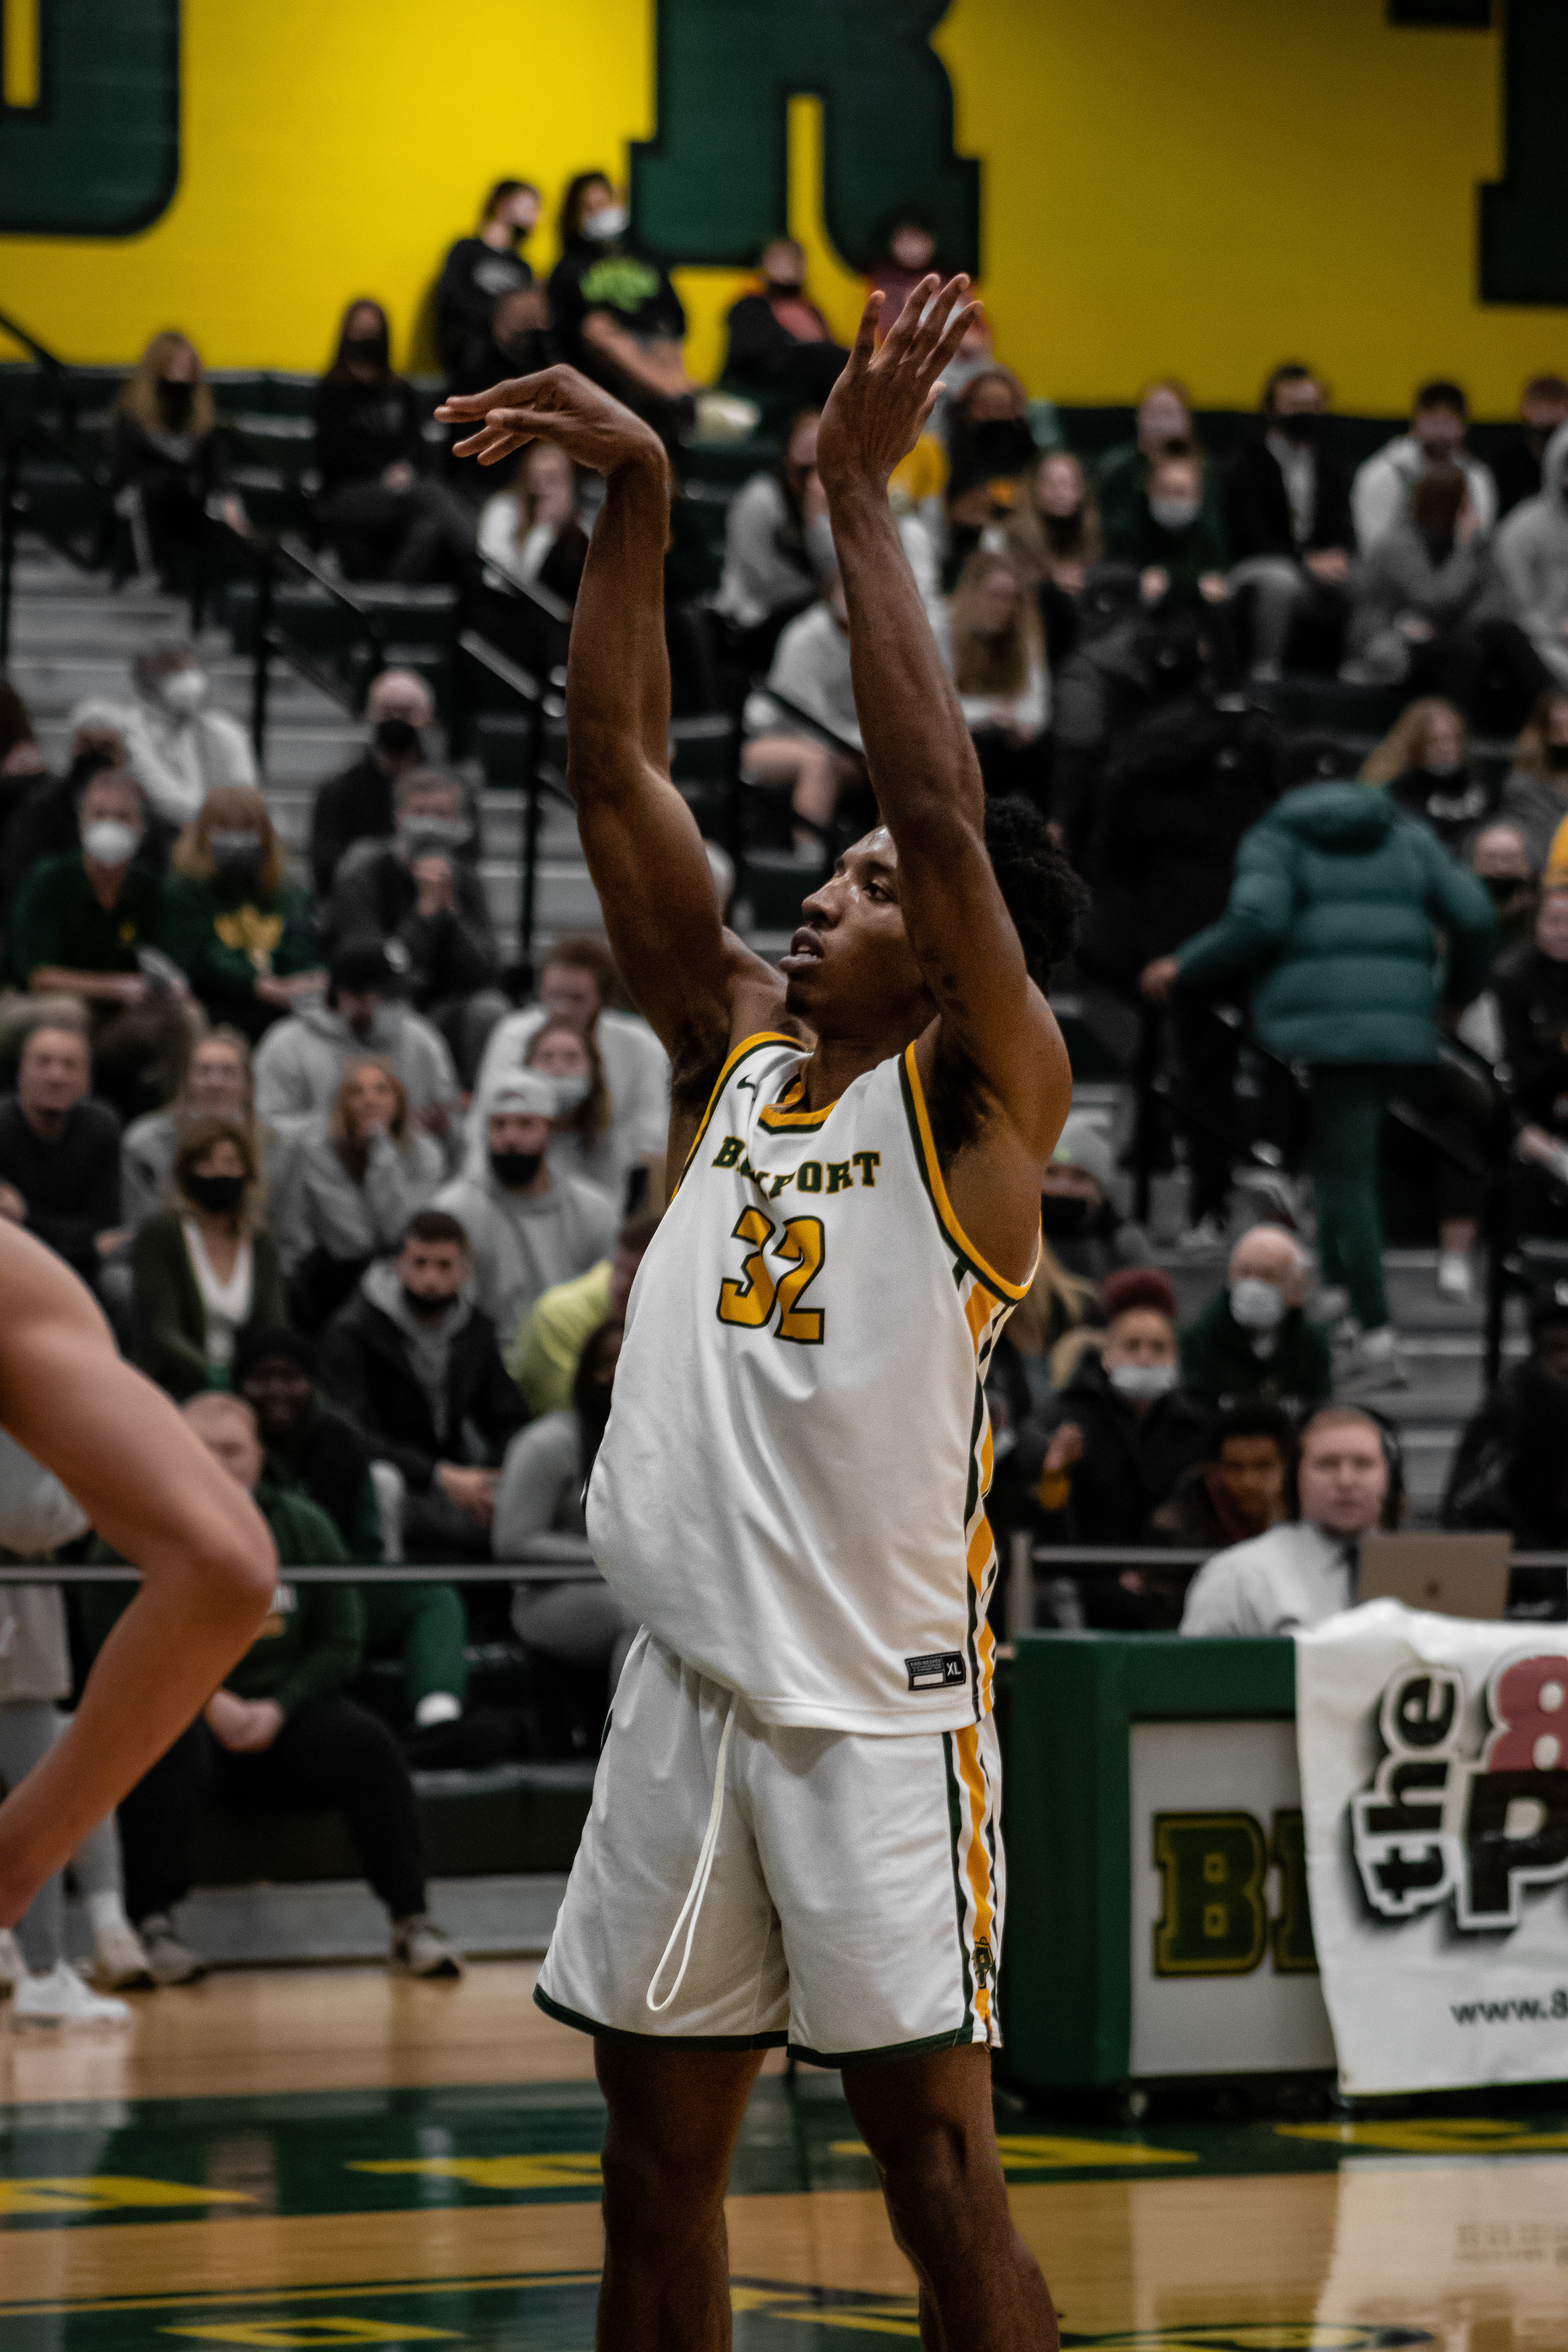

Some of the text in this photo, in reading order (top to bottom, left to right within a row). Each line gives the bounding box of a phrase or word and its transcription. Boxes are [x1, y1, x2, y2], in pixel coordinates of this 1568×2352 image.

[716, 1205, 826, 1345] 32
[946, 1661, 962, 1676] XL
[1366, 1674, 1457, 1903] the
